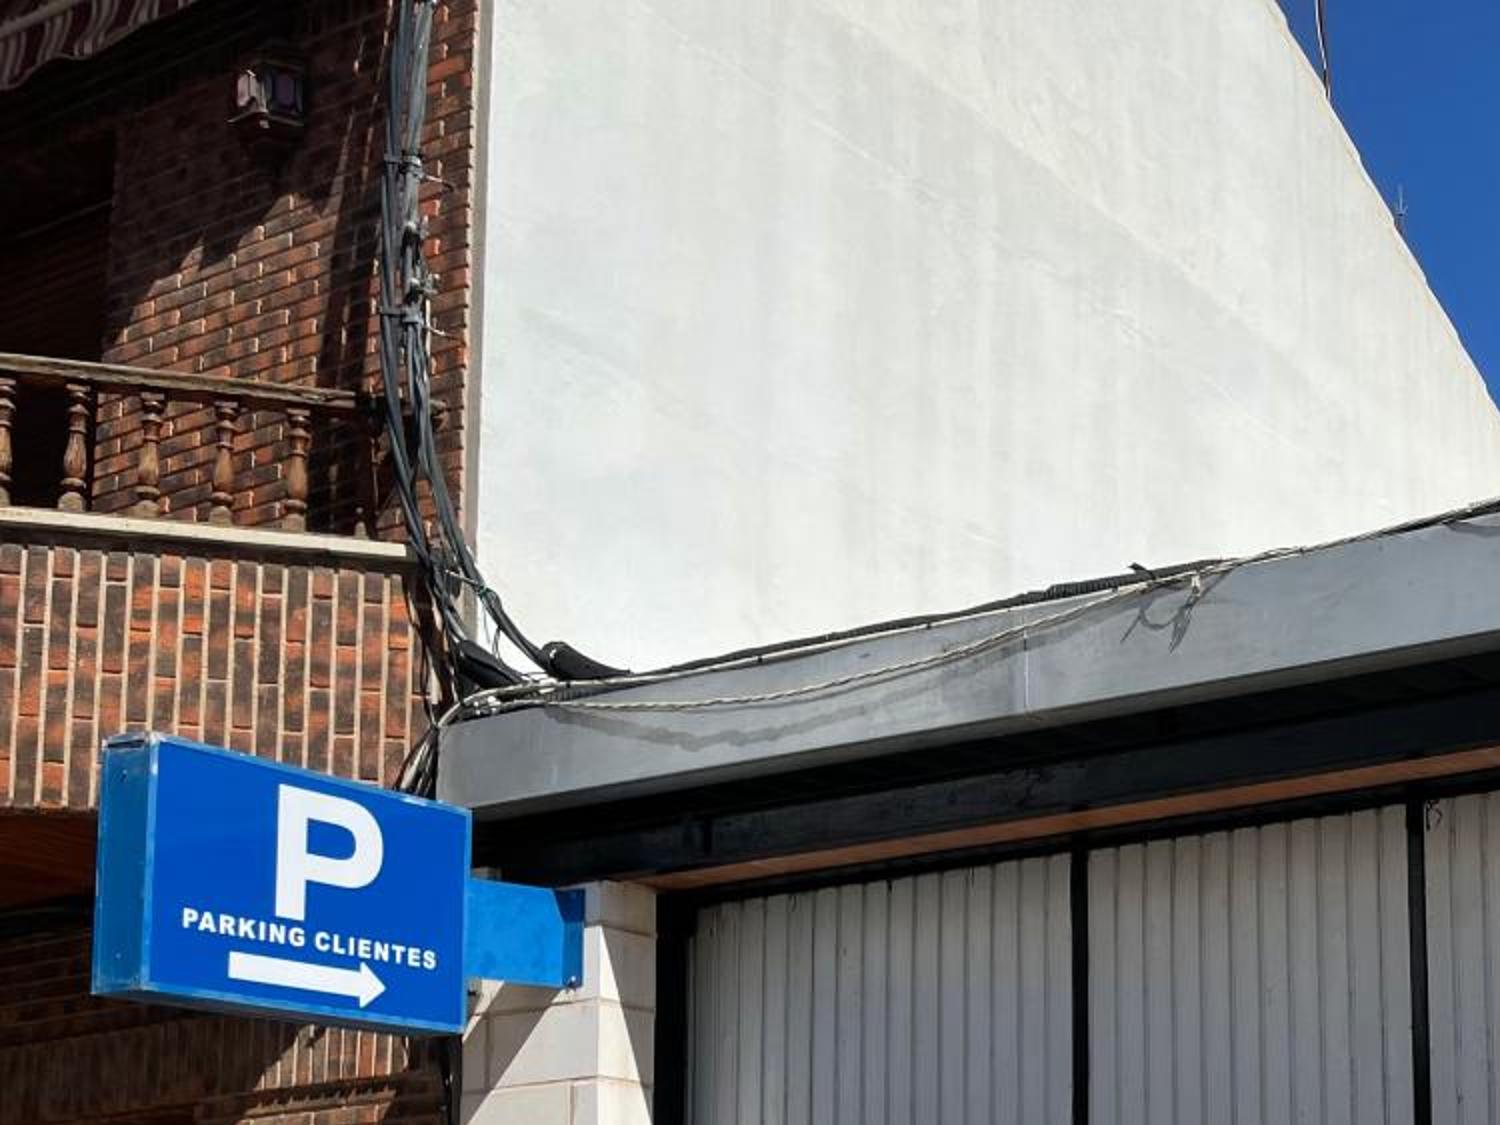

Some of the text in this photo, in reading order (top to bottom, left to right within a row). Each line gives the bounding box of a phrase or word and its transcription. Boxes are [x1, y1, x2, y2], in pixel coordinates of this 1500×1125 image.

[275, 783, 384, 921] P
[181, 906, 438, 970] PARKING CLIENTES
